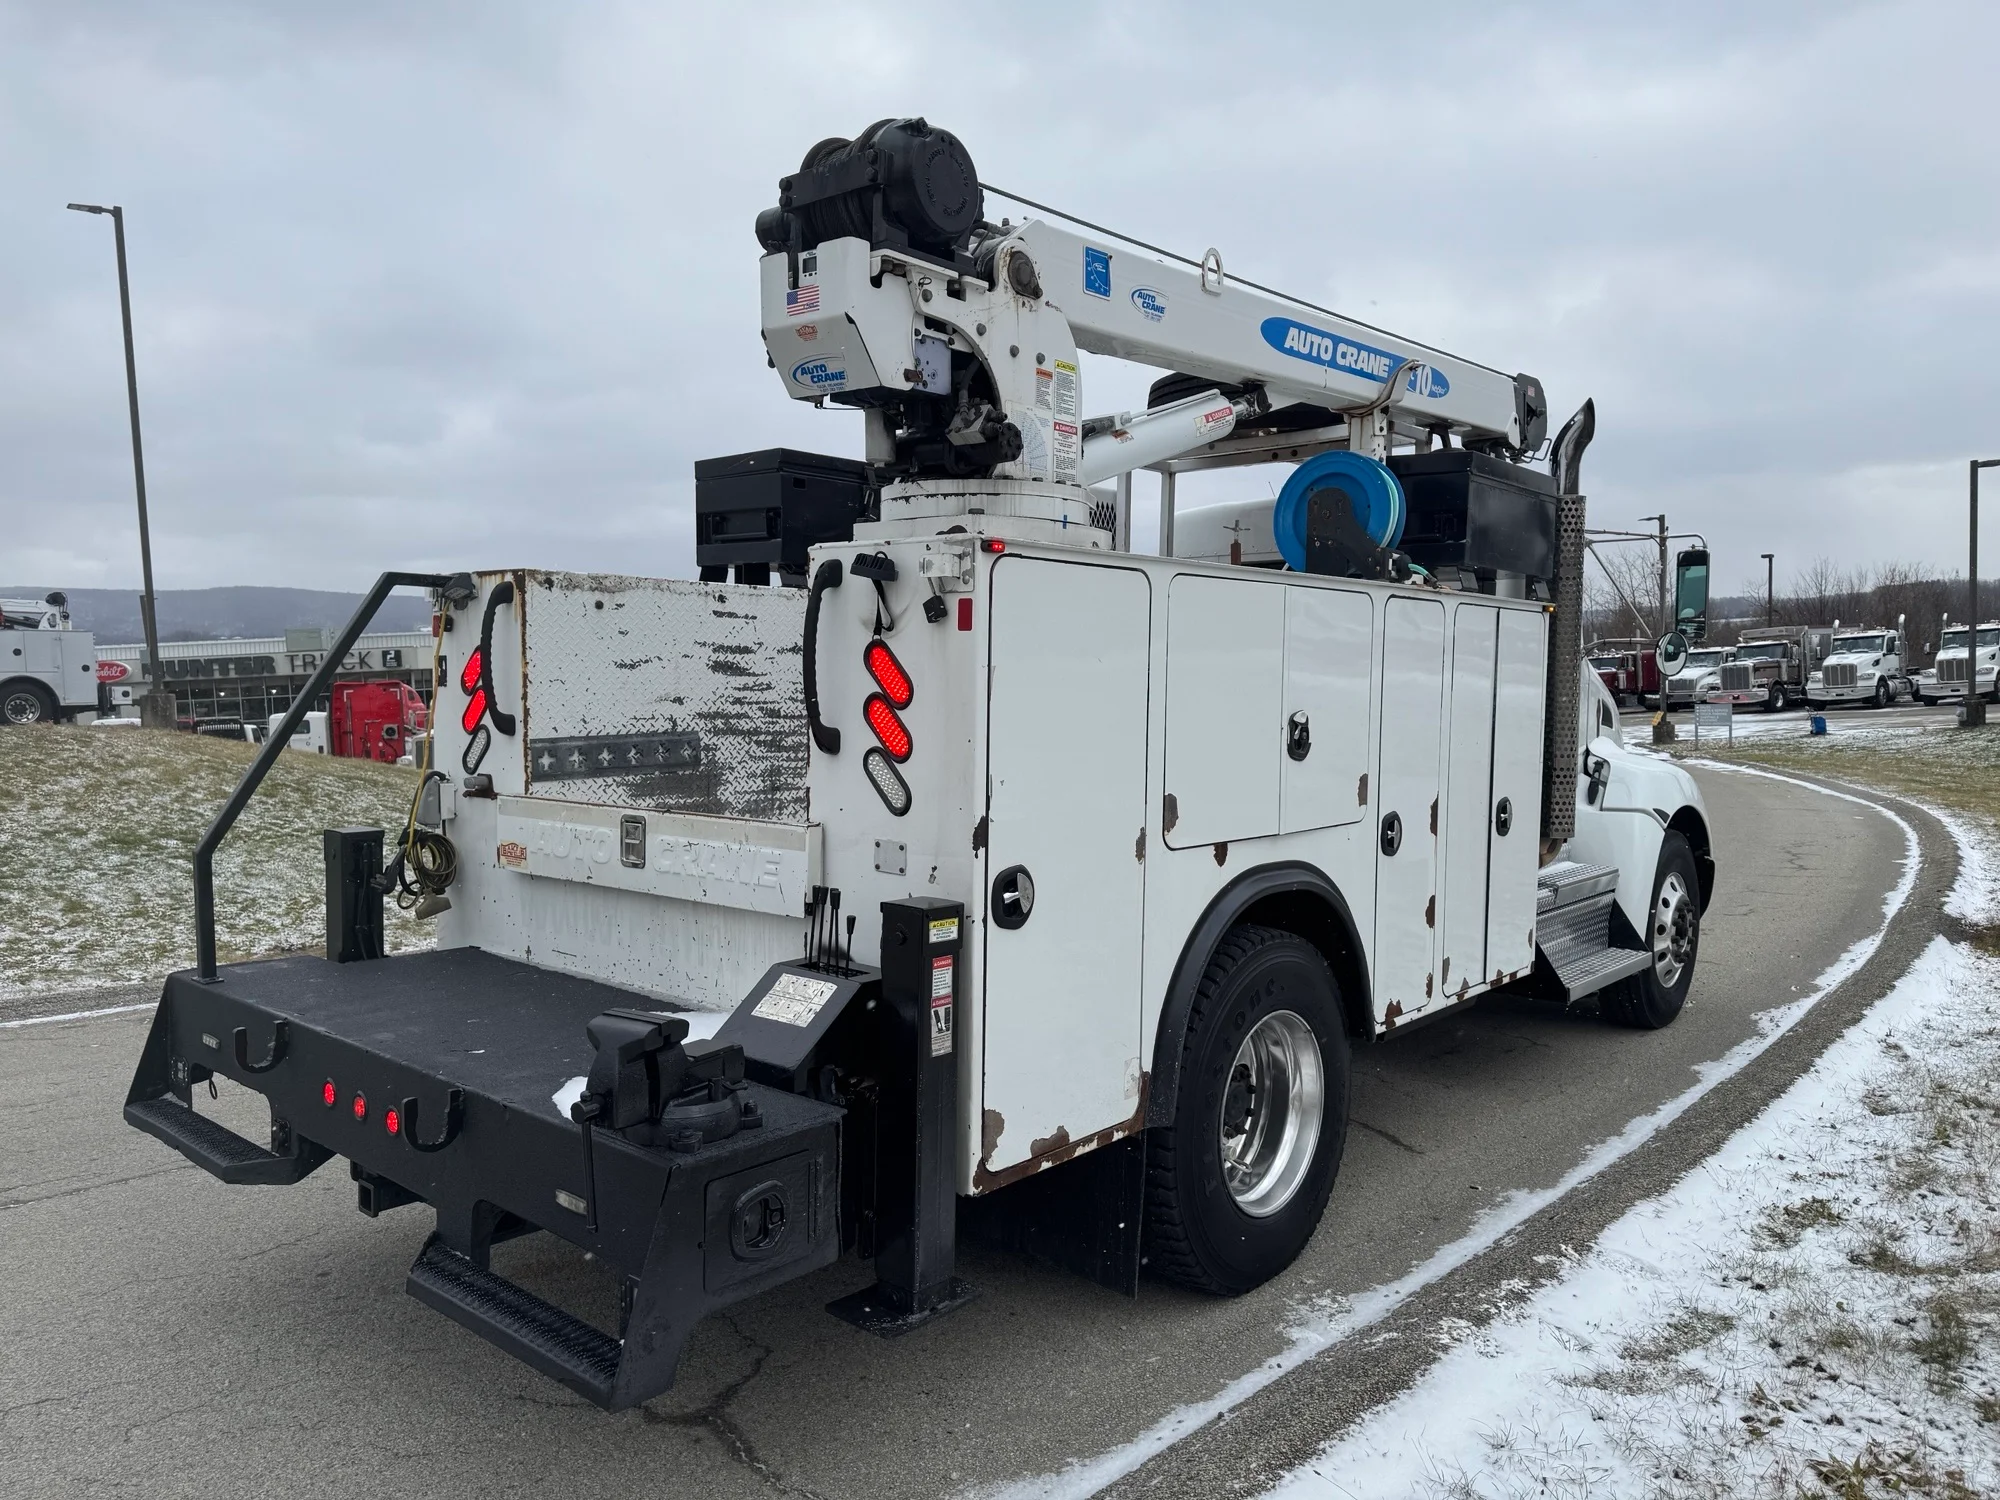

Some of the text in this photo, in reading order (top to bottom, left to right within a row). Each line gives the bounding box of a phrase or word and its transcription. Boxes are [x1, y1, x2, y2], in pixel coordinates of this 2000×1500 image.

[1137, 291, 1156, 303] AUTO
[1141, 300, 1167, 314] CRANE
[1284, 326, 1390, 379] AUTO CRANE
[800, 363, 827, 376] AUTO
[810, 370, 846, 384] CRANE
[1415, 364, 1432, 396] 10
[1212, 409, 1231, 420] DANGER
[1059, 424, 1077, 434] DANGER
[142, 651, 374, 679] HUNTER TRCK
[530, 820, 783, 889] AUTO CRANE
[936, 920, 956, 928] CAUTION
